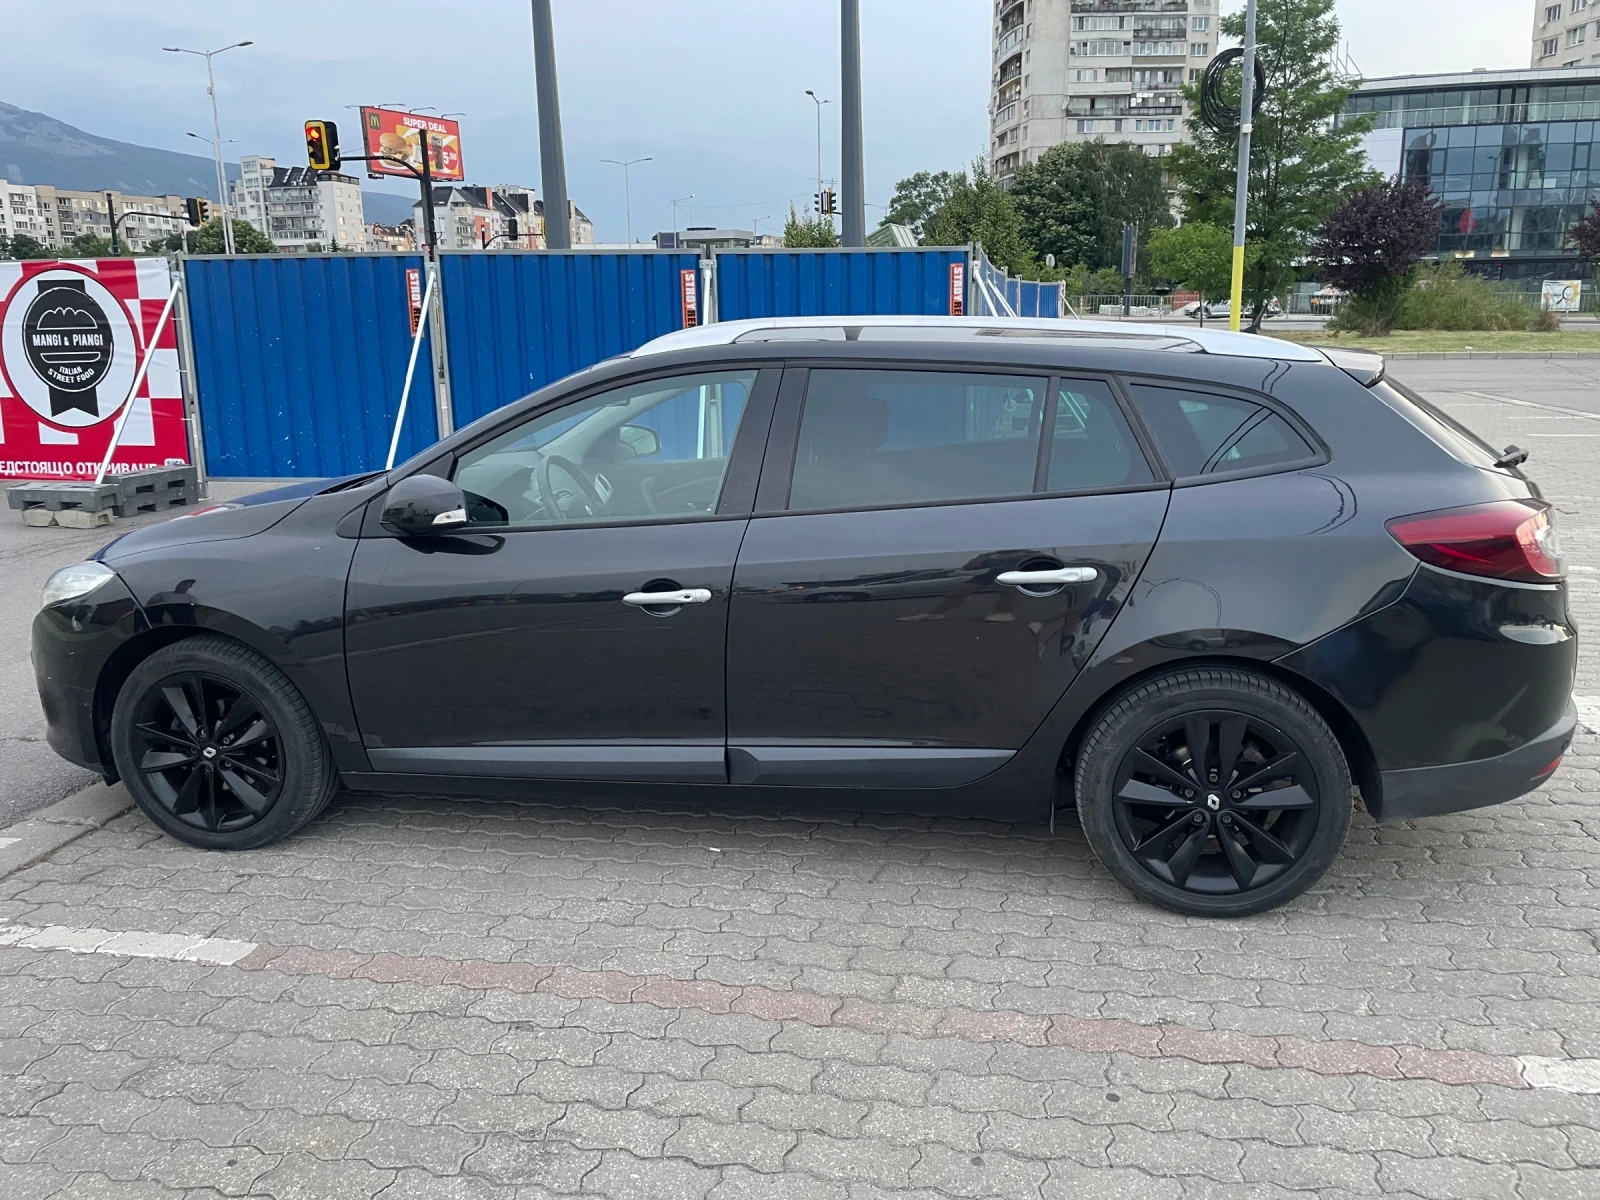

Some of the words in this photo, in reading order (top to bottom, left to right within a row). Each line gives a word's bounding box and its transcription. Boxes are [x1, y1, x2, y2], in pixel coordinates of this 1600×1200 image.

[403, 116, 427, 130] SUPER
[428, 121, 448, 133] DEAL
[953, 267, 963, 316] STROYRE
[409, 272, 422, 333] STROYREN
[32, 334, 61, 346] MANGI
[64, 336, 70, 346] &
[72, 333, 104, 346] PIANGI
[47, 367, 75, 383] STREET
[77, 367, 95, 383] FOOD
[59, 365, 82, 375] ITALIAN
